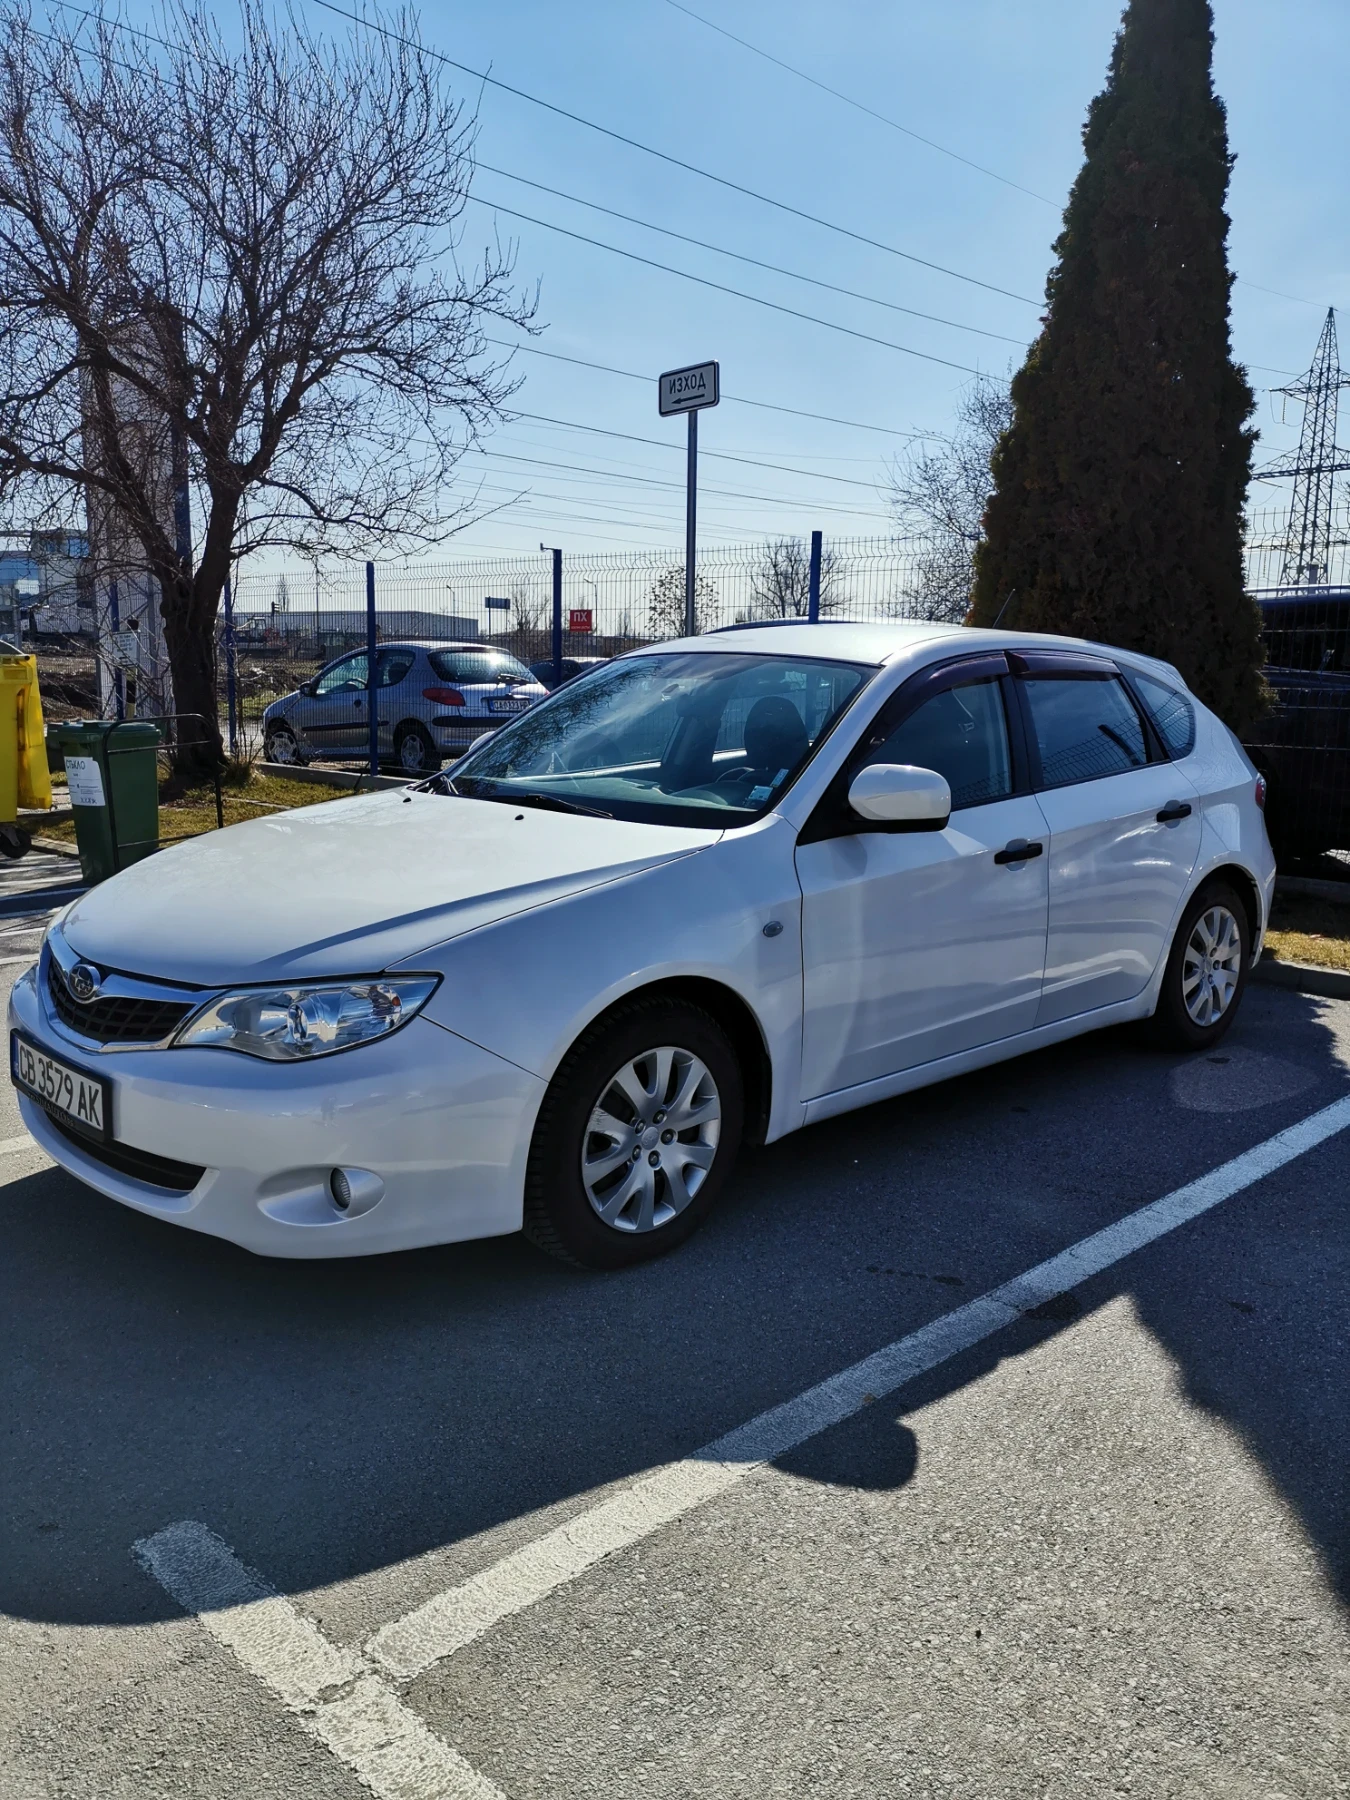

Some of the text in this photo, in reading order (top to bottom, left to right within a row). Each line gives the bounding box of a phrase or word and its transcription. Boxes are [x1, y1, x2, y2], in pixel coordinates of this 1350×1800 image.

[669, 372, 706, 394] ИЗХОД
[20, 1044, 36, 1086] CB
[38, 1058, 74, 1111] 3579
[77, 1081, 101, 1127] AK
